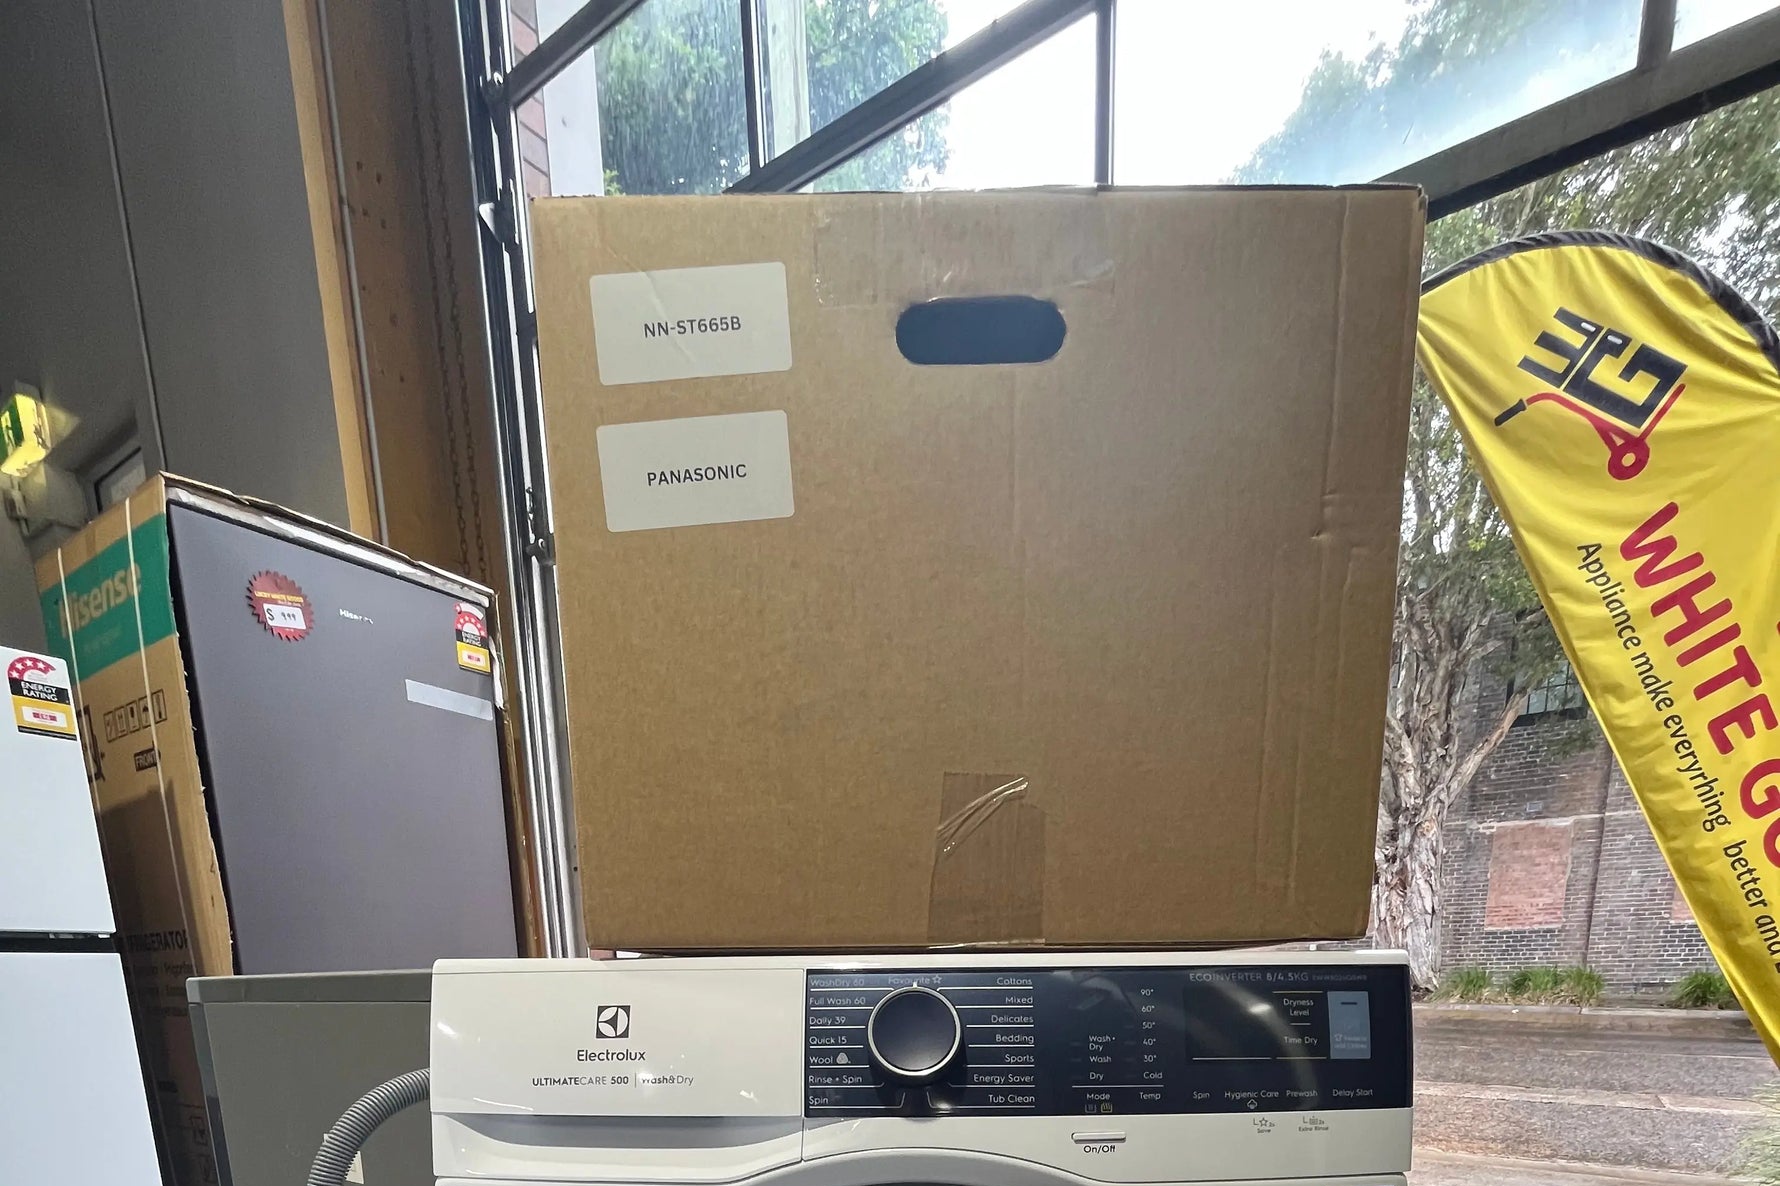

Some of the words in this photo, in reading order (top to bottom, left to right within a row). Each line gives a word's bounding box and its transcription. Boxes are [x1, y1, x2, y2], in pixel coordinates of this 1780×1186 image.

[644, 315, 742, 338] NN-ST665B
[647, 463, 747, 486] PANASONIC
[1619, 501, 1779, 755] WHITE
[21, 681, 57, 694] ENERGY
[23, 689, 58, 701] RATING
[1577, 542, 1642, 650] Appliance
[1631, 651, 1675, 712] make
[1723, 839, 1768, 908] better
[996, 976, 1032, 986] Cottons
[809, 996, 822, 1005] Full
[824, 996, 851, 1005] Wash
[854, 996, 866, 1005] 60
[1005, 995, 1033, 1004] Mixed
[1283, 998, 1314, 1007] Dryness
[809, 1016, 832, 1026] Daily
[835, 1016, 846, 1024] 39
[991, 1014, 1034, 1024] Delicates
[809, 1035, 834, 1045] Quick
[837, 1035, 847, 1044] 15
[995, 1034, 1034, 1045] Bedding
[1089, 1034, 1111, 1042] Wash
[1284, 1036, 1302, 1044] Time
[1304, 1036, 1318, 1045] Dry
[1089, 1043, 1103, 1051] Dry
[577, 1049, 646, 1062] Electrolux
[809, 1055, 833, 1065] Wool
[1005, 1054, 1034, 1064] Sports
[1090, 1055, 1111, 1063] Wash
[808, 1074, 832, 1084] Rinse
[842, 1074, 862, 1085] Spin
[973, 1074, 1004, 1084] Energy
[1007, 1073, 1035, 1083] Saver
[1090, 1072, 1104, 1080] Dry
[1143, 1071, 1163, 1079] Cold
[532, 1075, 607, 1087] ULTIMATECARE
[610, 1076, 629, 1085] 500
[1086, 1092, 1110, 1100] Mode
[1140, 1091, 1161, 1101] Temp
[1193, 1091, 1210, 1099] Spin
[1224, 1090, 1258, 1099] Hygienic
[1260, 1090, 1279, 1098] Care
[1286, 1089, 1318, 1097] Prewash
[1332, 1088, 1354, 1098] Delay
[1355, 1088, 1373, 1096] Start
[809, 1095, 828, 1106] Spin
[988, 1094, 1004, 1103] Tub
[1007, 1094, 1035, 1103] Clean
[1083, 1145, 1116, 1154] On/Off
